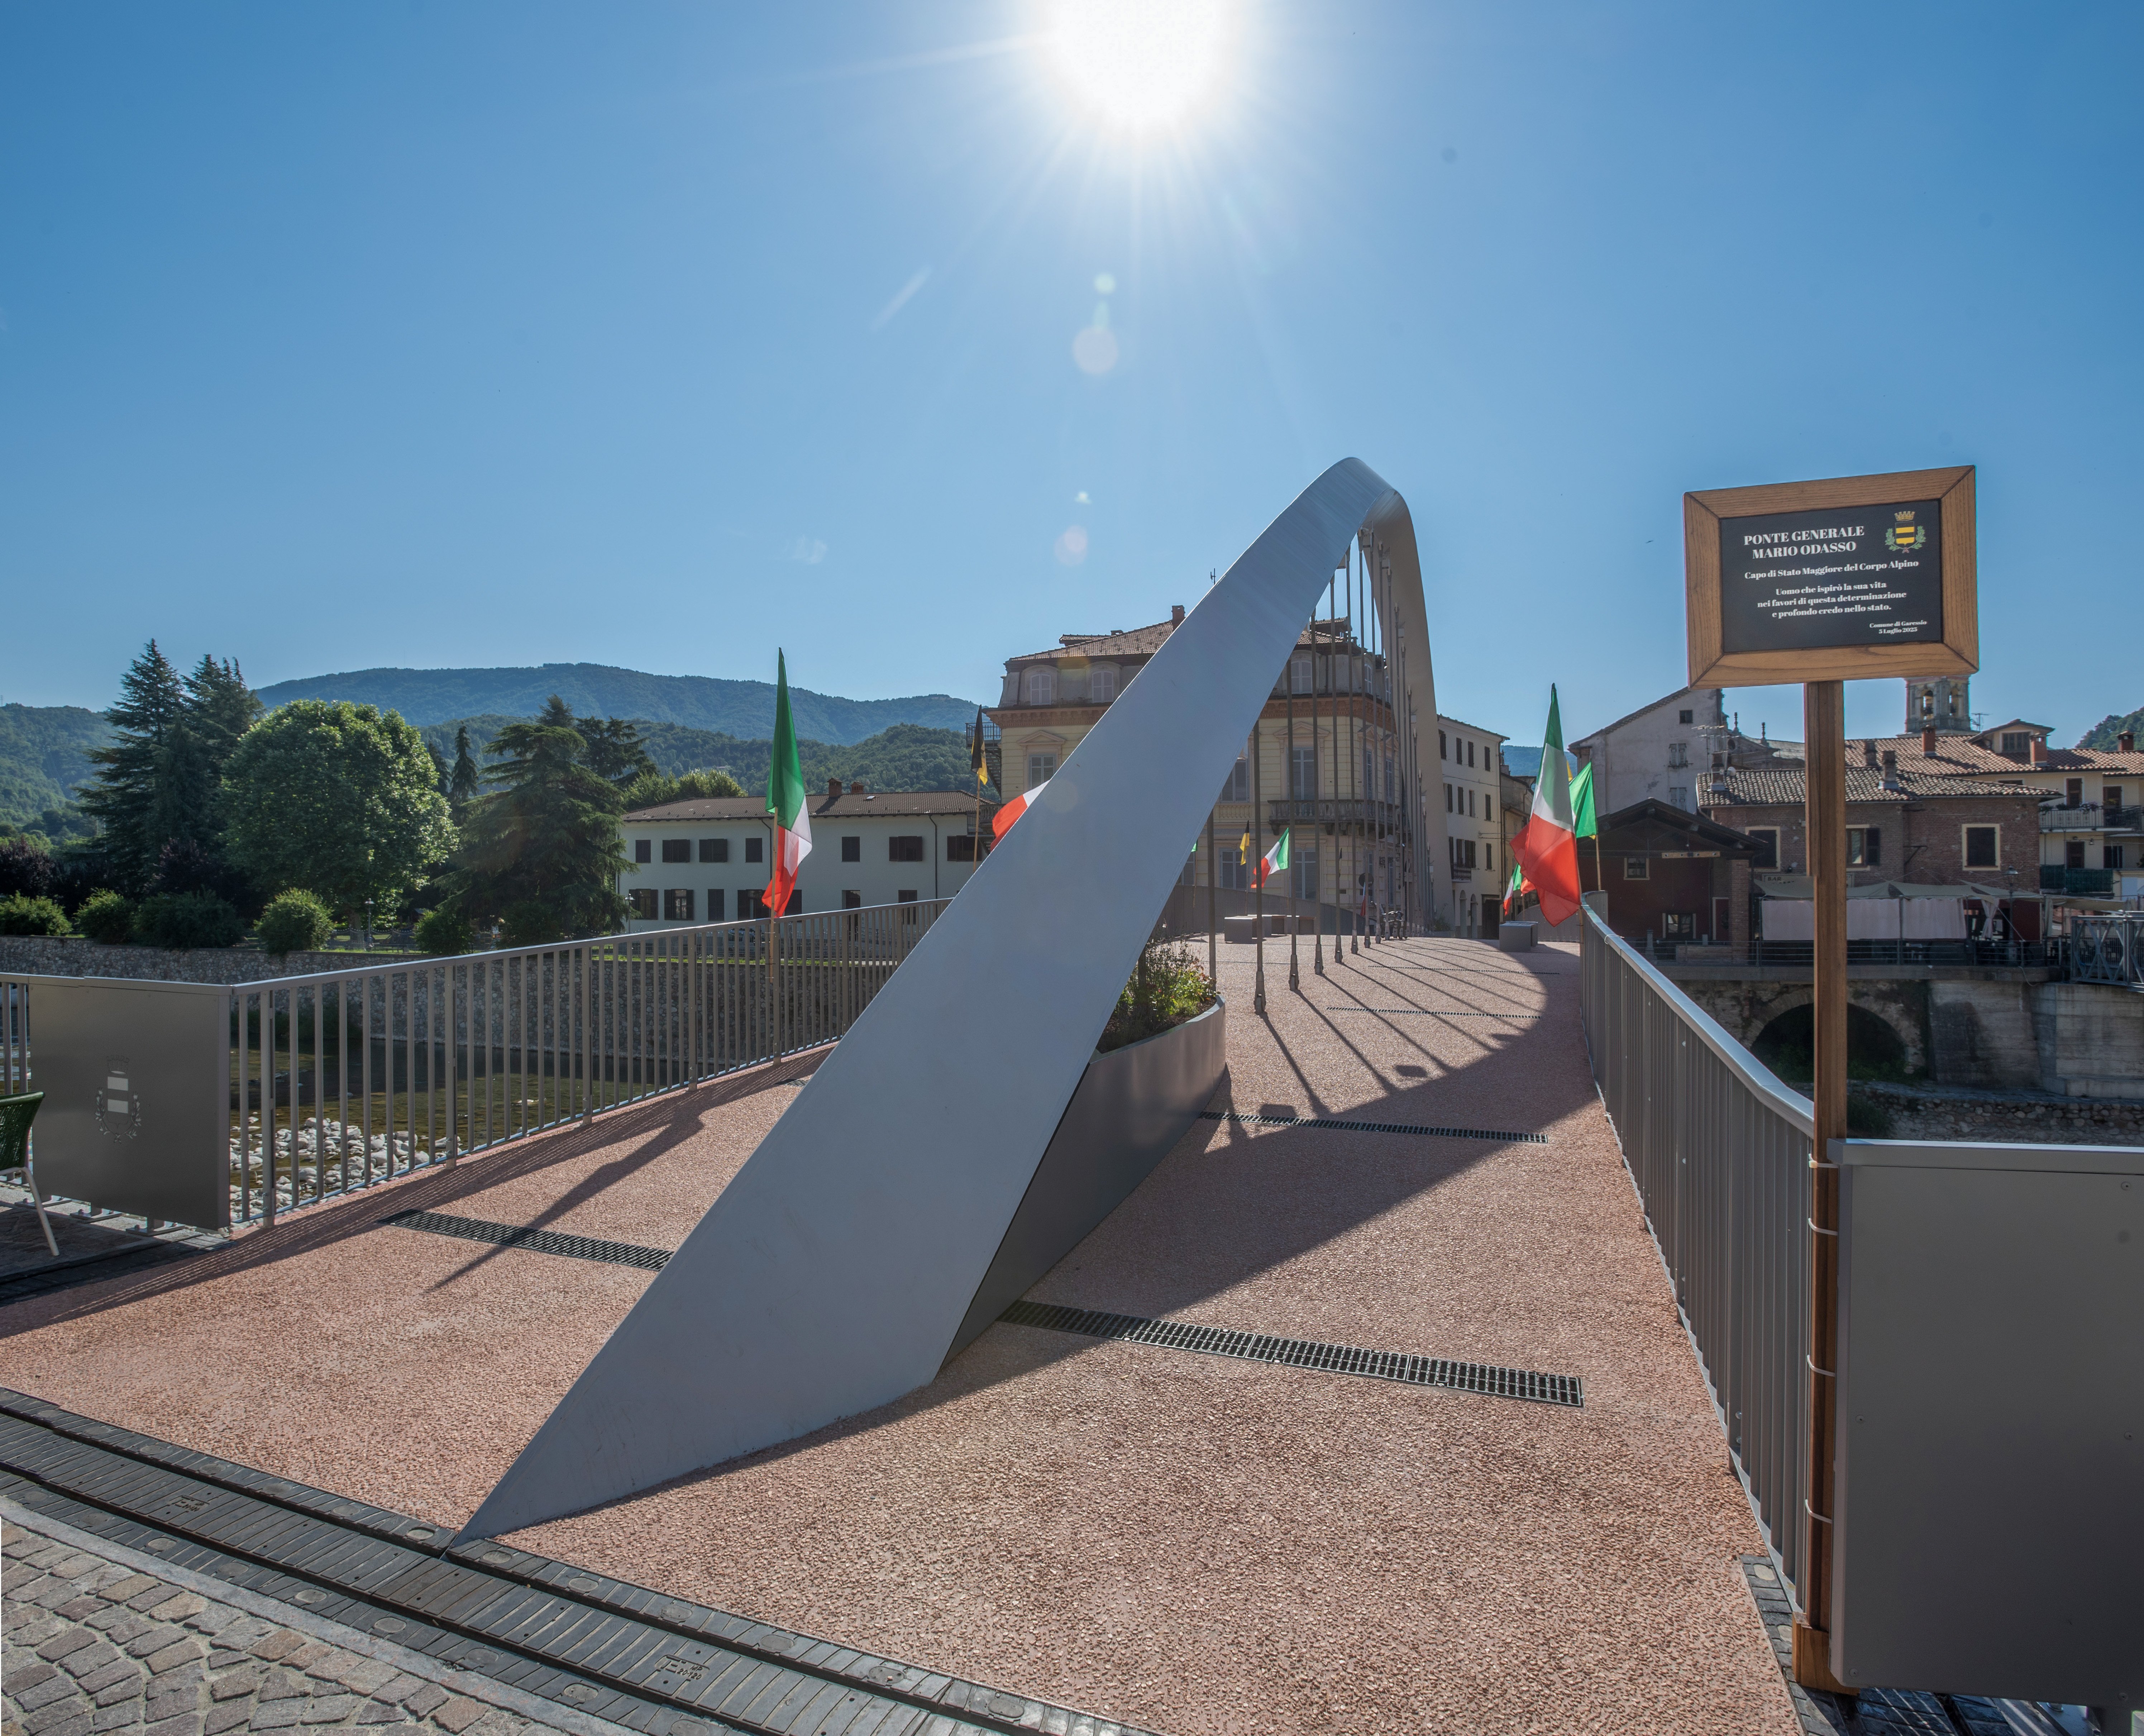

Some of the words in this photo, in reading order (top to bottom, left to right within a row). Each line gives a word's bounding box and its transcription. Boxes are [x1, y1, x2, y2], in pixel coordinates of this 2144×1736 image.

[1744, 532, 1789, 545] PONTE
[1791, 526, 1864, 541] GENERALE
[1752, 546, 1798, 559] MARIO
[1800, 541, 1857, 555] ODASSO
[1744, 572, 1766, 580] Capo
[1802, 566, 1843, 576] Maggiore
[1859, 563, 1887, 571] Corpo
[1888, 560, 1919, 569] Alpino
[1817, 584, 1842, 593] ispirò
[1772, 598, 1797, 606] favori
[1808, 595, 1836, 606] questa
[1837, 592, 1907, 602] determinazione
[1778, 608, 1818, 619] profondo
[1818, 606, 1843, 614] credo
